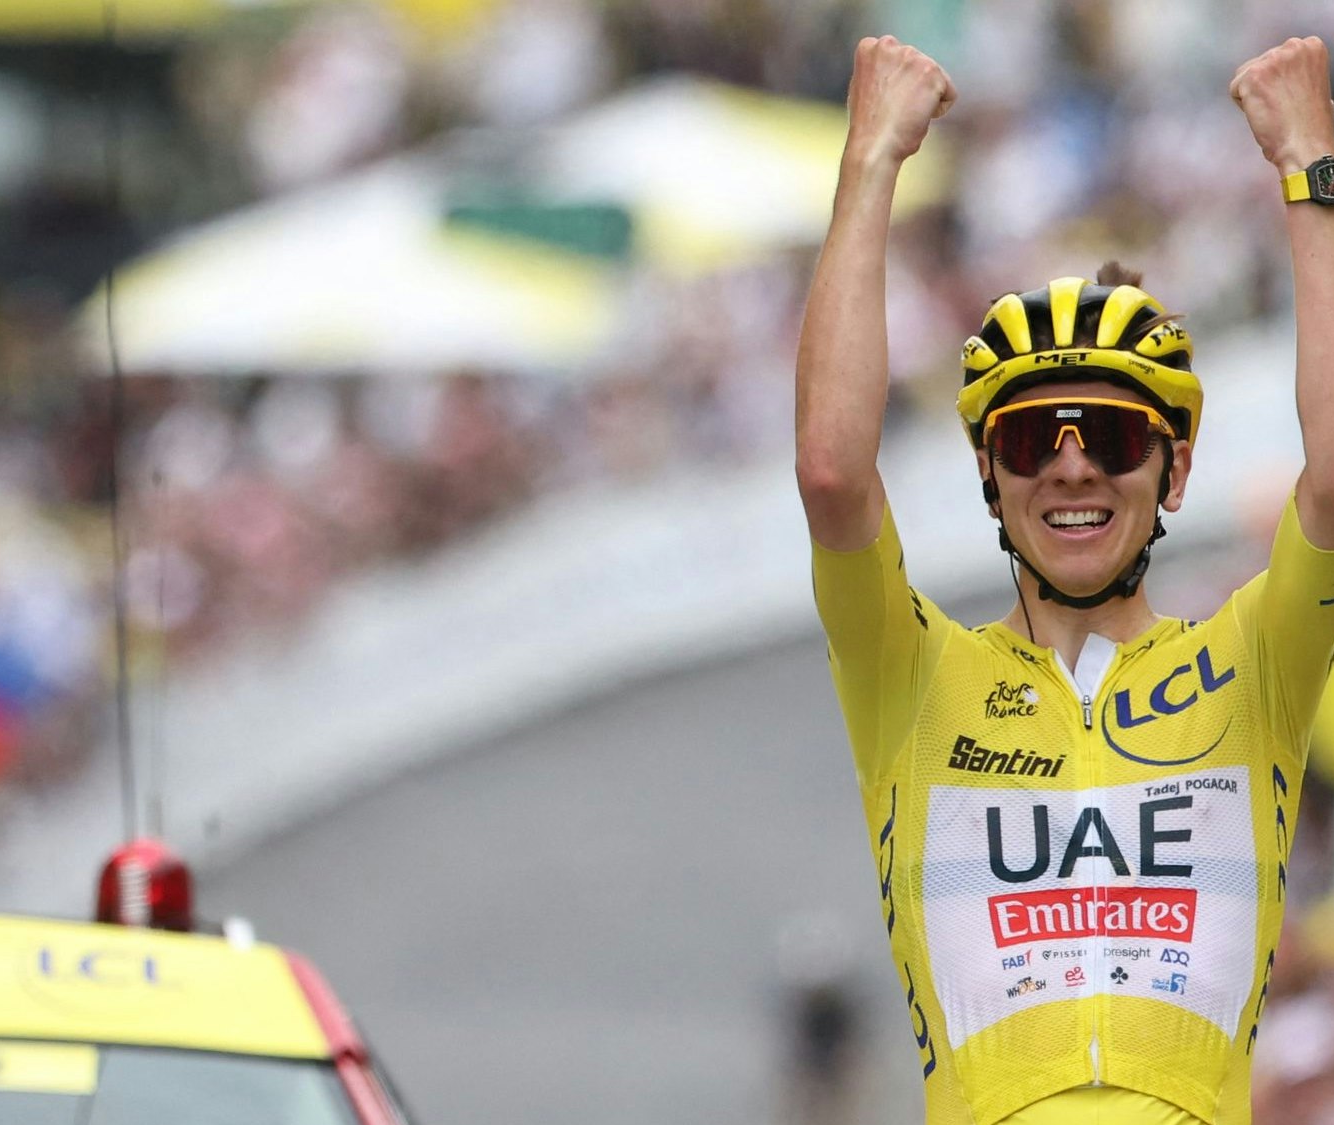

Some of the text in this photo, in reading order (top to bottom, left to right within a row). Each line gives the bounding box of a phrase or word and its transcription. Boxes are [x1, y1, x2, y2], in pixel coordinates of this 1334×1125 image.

[1034, 351, 1092, 366] MET
[1114, 645, 1236, 729] LCL
[948, 734, 1067, 778] Santini
[1144, 782, 1180, 797] Tadej
[986, 796, 1193, 883] UAE
[994, 893, 1190, 939] Emirates
[1103, 946, 1151, 961] presight
